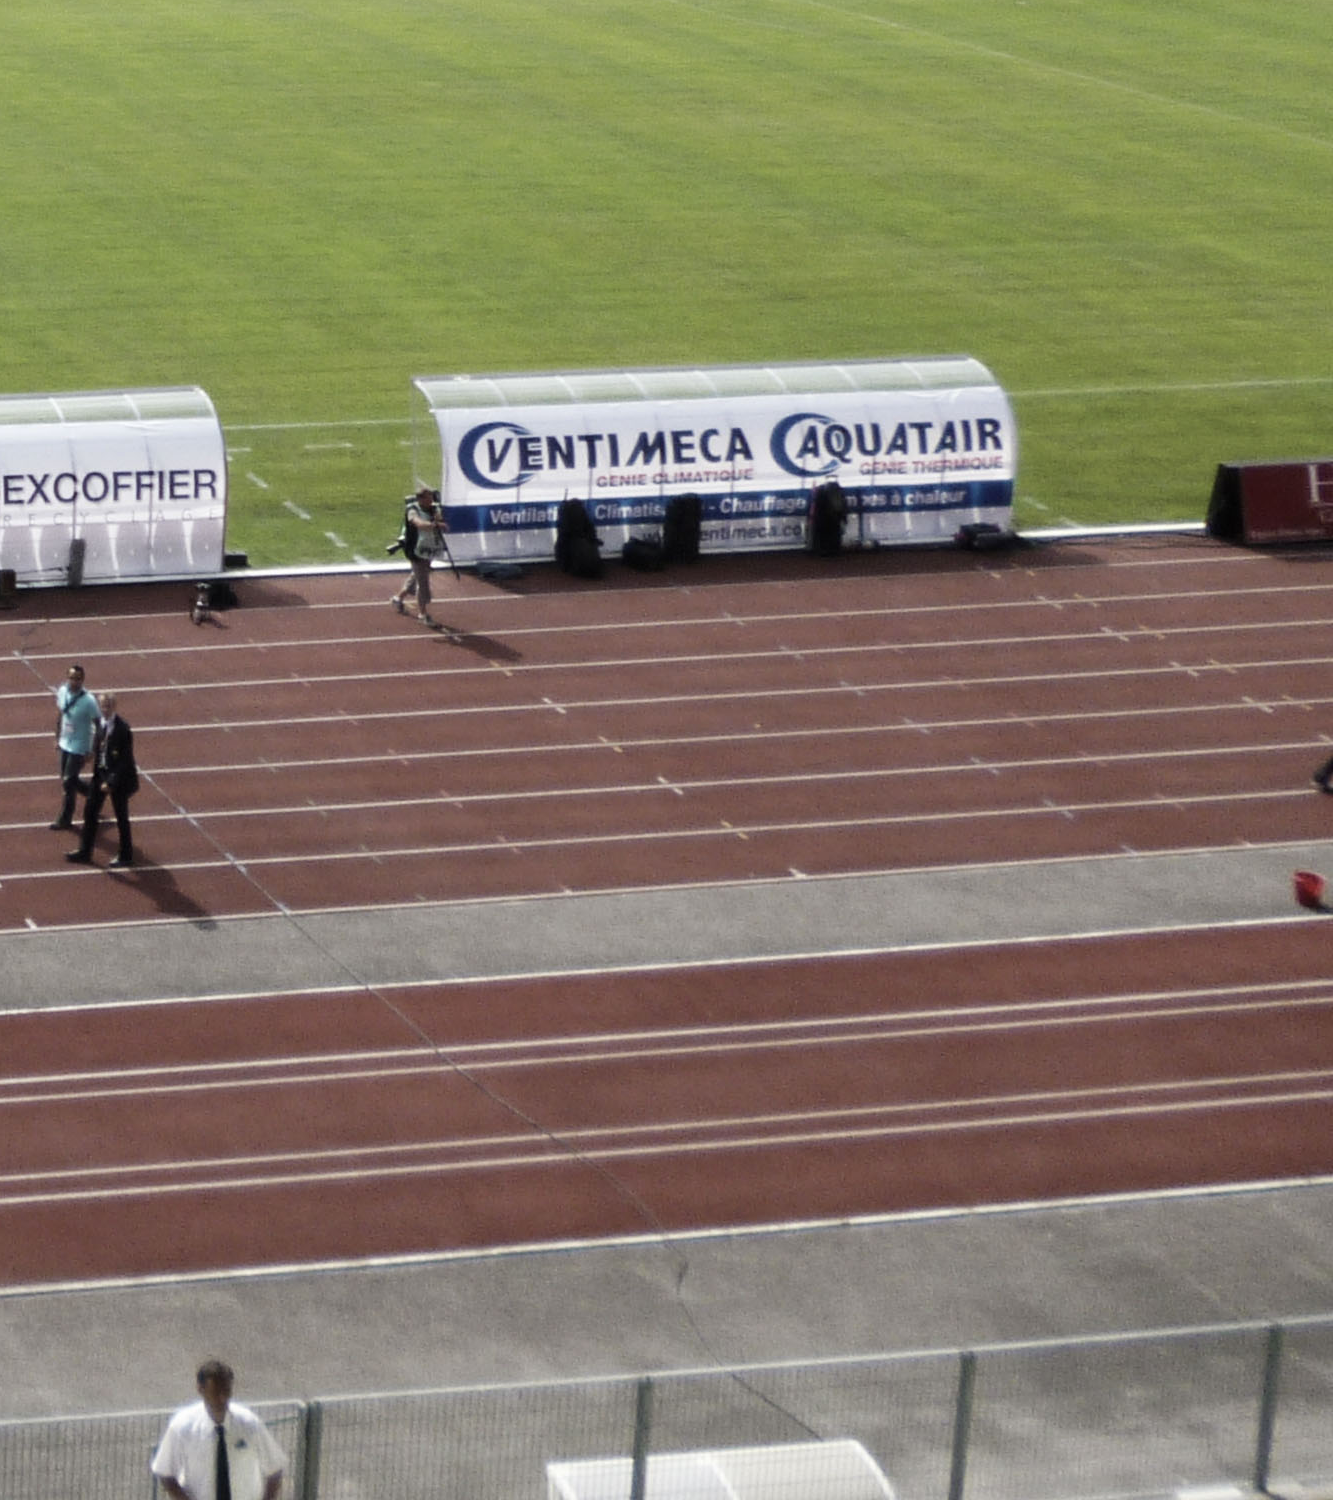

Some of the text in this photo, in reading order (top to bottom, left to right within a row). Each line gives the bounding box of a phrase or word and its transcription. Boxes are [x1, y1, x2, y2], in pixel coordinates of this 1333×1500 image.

[486, 427, 753, 474] VENTIMECA
[795, 418, 1004, 463] AQUATAIR
[596, 468, 754, 488] GENIE CLIMATIQUE
[858, 456, 1004, 475] GENIE THERMIQUE
[3, 469, 217, 506] EXCOFFIER
[720, 495, 807, 514] Chauffage
[892, 491, 901, 506] à
[904, 488, 968, 505] chaleur
[3, 508, 217, 526] RECYCLAGE
